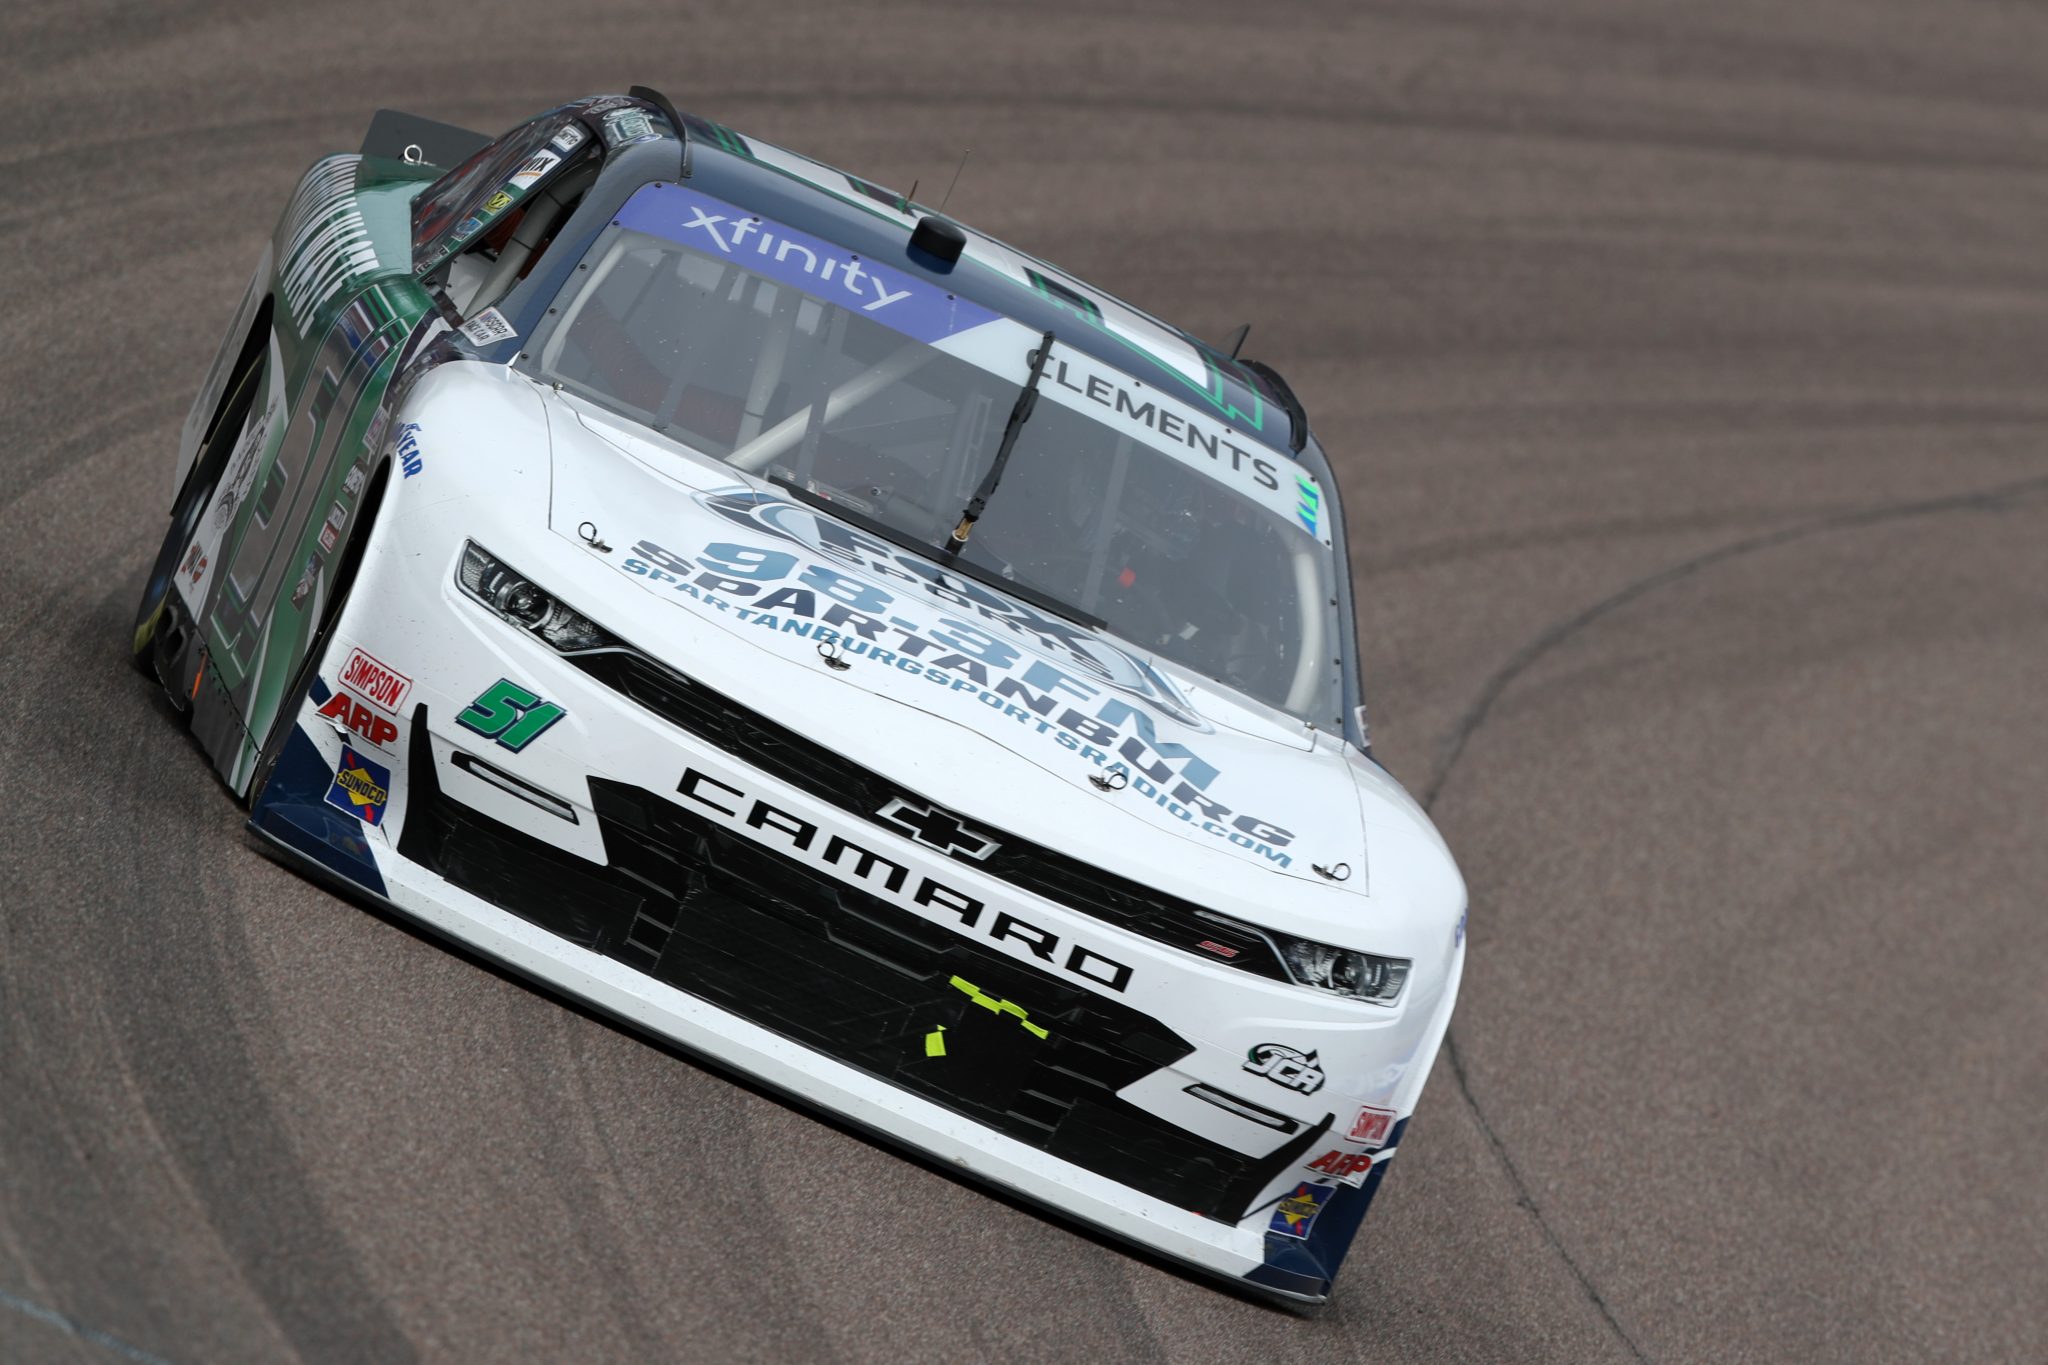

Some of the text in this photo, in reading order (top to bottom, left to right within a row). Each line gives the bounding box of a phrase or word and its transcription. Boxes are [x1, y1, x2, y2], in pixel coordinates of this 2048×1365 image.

[681, 206, 913, 312] xfinity
[1026, 348, 1280, 491] CLEMENTS
[819, 541, 1116, 681] SPORTS
[318, 691, 399, 747] ARP
[343, 654, 406, 708] SIMPSON
[455, 677, 568, 754] 51
[621, 557, 1294, 870] SPARTANBURGSPORTSRADIO.COM
[630, 539, 1297, 848] SPARTANBURG
[339, 770, 388, 805] SUNOCO
[675, 766, 1135, 995] CAMARO
